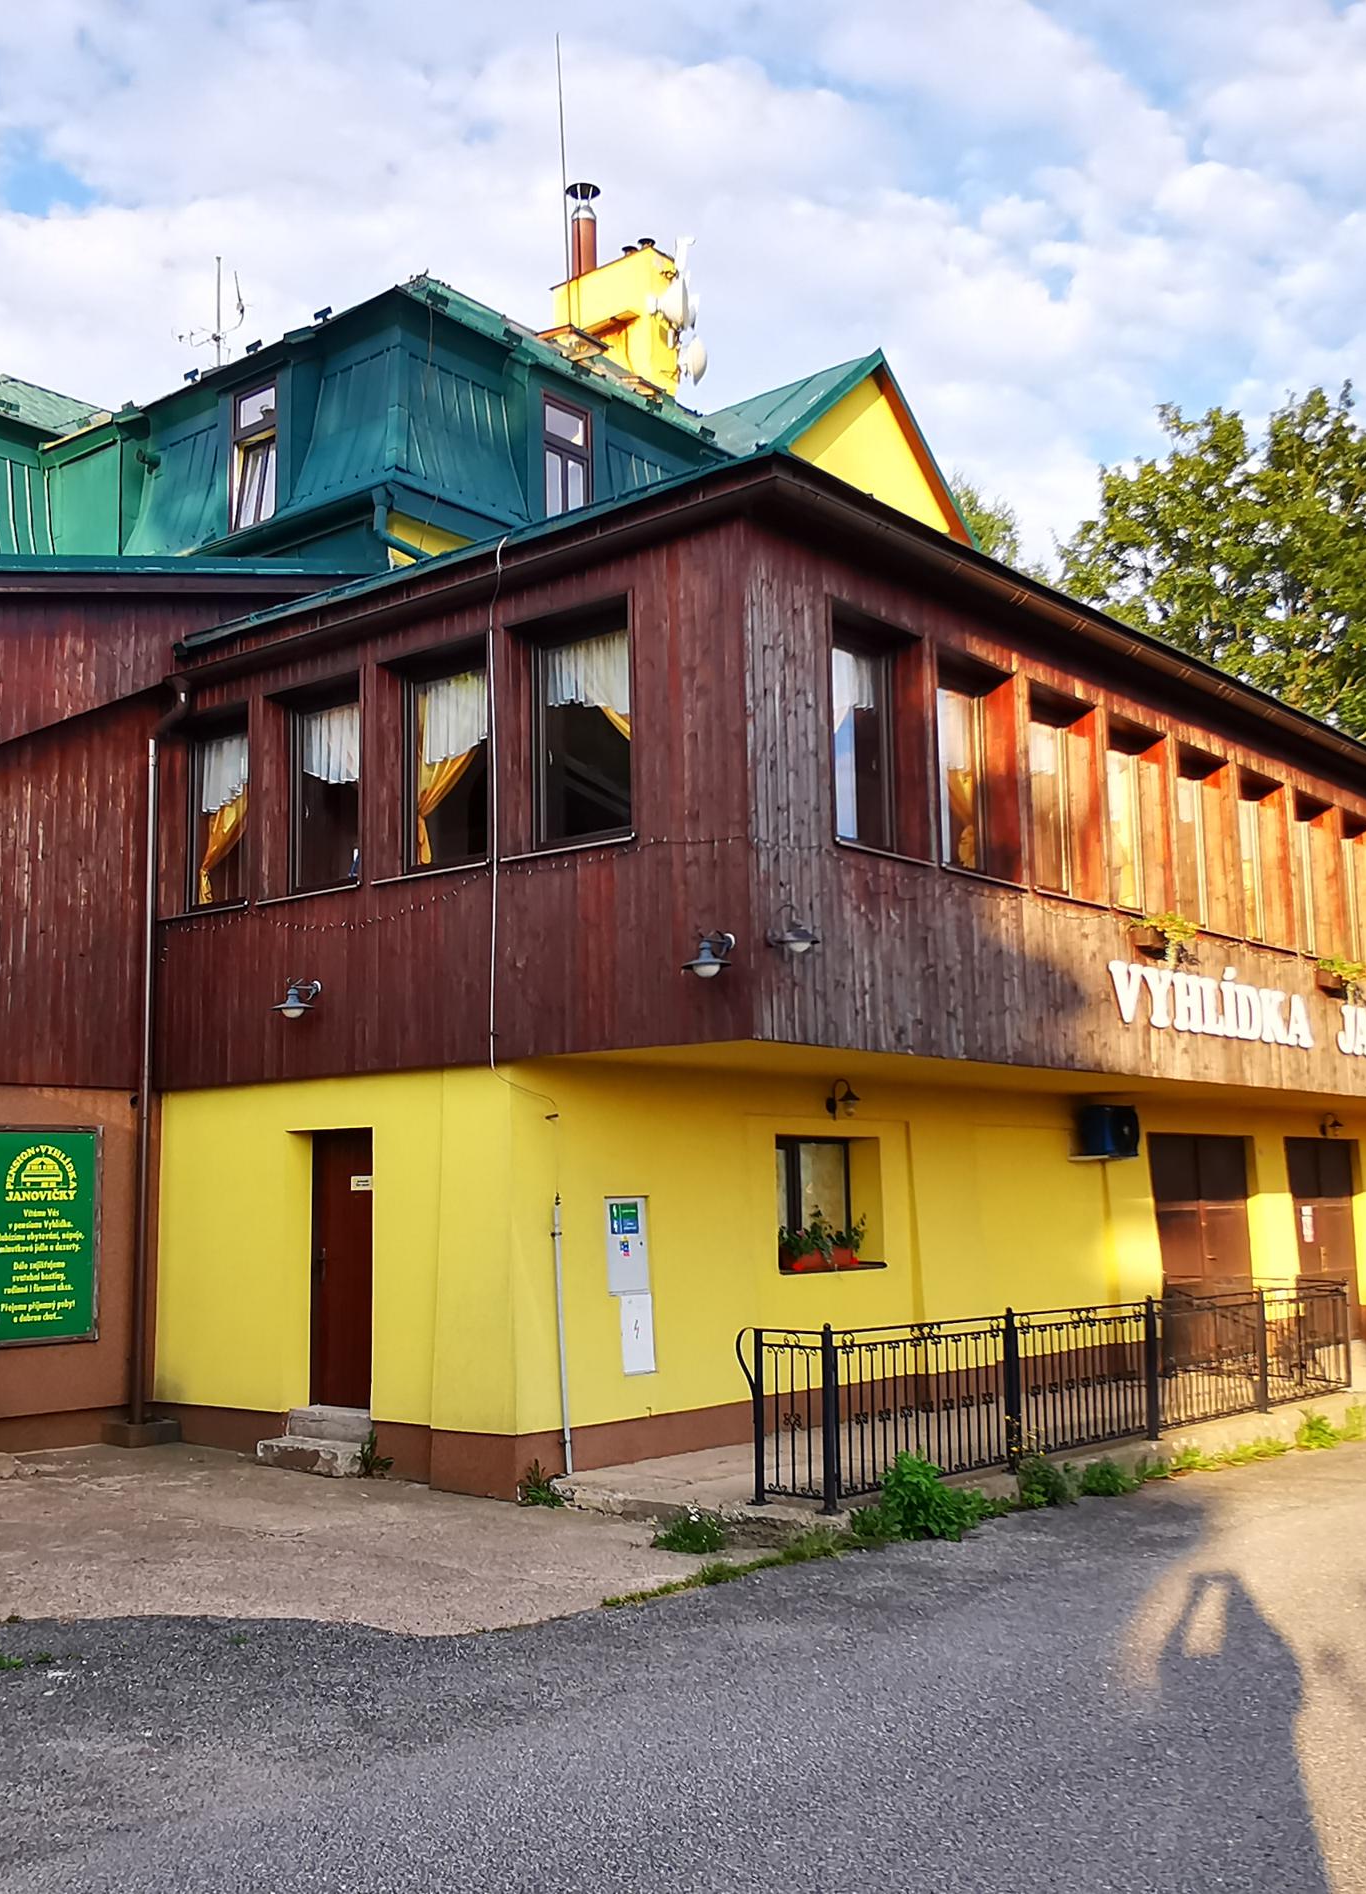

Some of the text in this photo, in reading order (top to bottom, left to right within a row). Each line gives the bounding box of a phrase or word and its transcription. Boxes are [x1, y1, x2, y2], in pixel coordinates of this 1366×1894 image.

[1108, 959, 1314, 1049] VYHLÍDKA
[5, 1145, 77, 1189] PENSION VYHLÍDKA
[5, 1188, 77, 1201] JANOVIČKY
[47, 1207, 60, 1217] Vás
